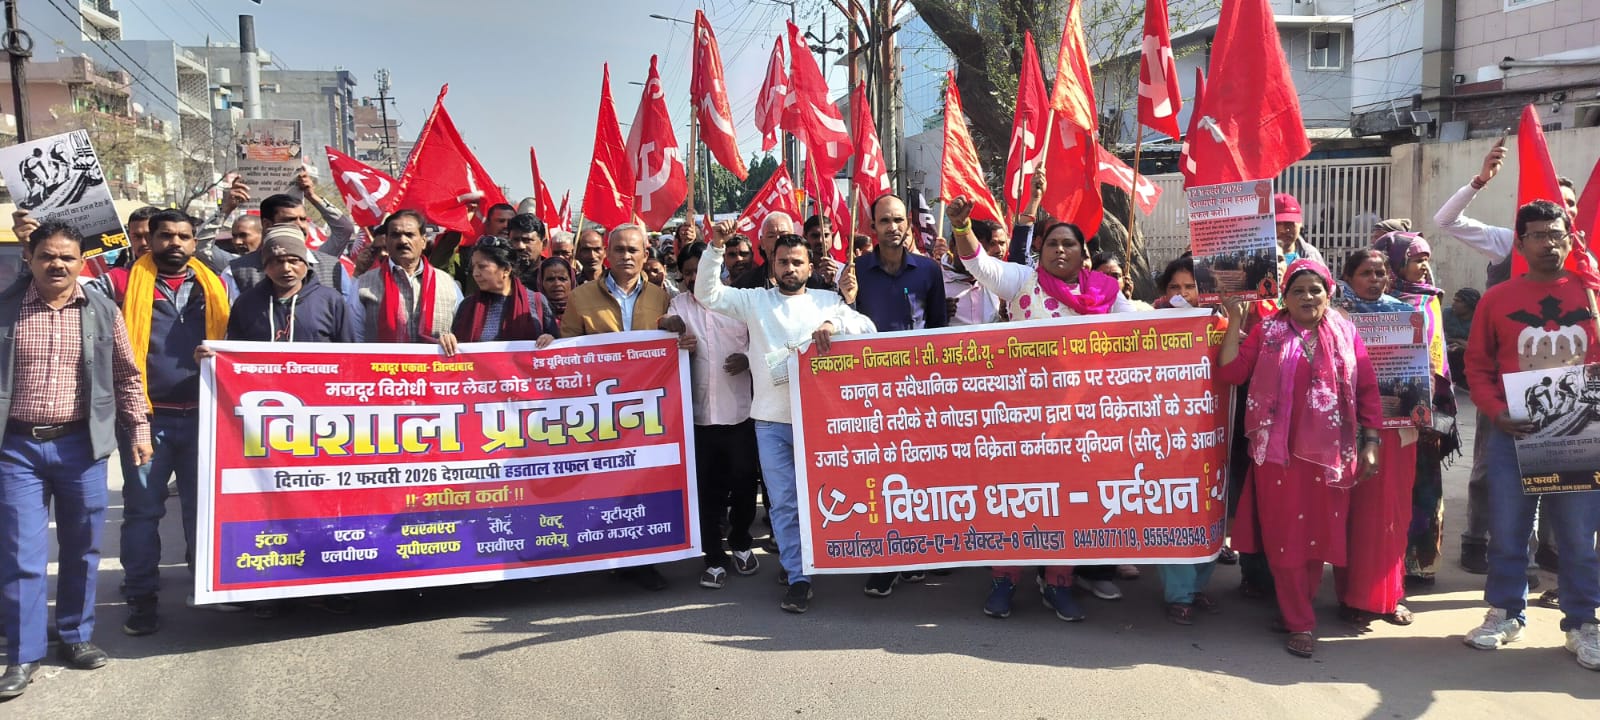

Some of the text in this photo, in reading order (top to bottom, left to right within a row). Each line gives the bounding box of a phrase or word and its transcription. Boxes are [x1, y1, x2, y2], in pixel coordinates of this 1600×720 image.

[1221, 184, 1243, 194] 2026
[101, 232, 129, 247] ऐक्टू
[1069, 338, 1087, 355] पथ
[1089, 329, 1140, 357] विक्रेताओं
[1142, 327, 1157, 351] की
[1160, 331, 1193, 350] एकता
[370, 362, 399, 375] मजदूर
[532, 356, 545, 369] ट्रेड
[583, 352, 595, 363] की
[325, 382, 376, 402] मजदूर
[378, 379, 428, 398] विरोधी
[462, 378, 498, 395] लेबर
[535, 375, 552, 392] रद्द
[556, 372, 584, 389] करो
[840, 355, 1211, 408] कानून व संवैधानिक व्यवस्थाओं को ताक पर रखकर मनमानी
[234, 379, 666, 457] विशाल प्रदर्शन
[826, 409, 883, 435] तानाशाही
[886, 407, 921, 430] तरीके
[924, 410, 937, 429] से
[940, 405, 978, 427] नोएडा
[981, 401, 1042, 428] प्राधिकरण
[1045, 403, 1072, 424] द्वारा
[1075, 402, 1096, 420] पथ
[1099, 394, 1163, 422] विक्रेताओं
[1164, 392, 1180, 415] के
[851, 442, 880, 465] जाने
[883, 441, 897, 462] के
[900, 439, 947, 464] खिलाफ
[951, 443, 971, 459] पथ
[974, 435, 1016, 461] विक्रेता
[1020, 433, 1072, 457] कर्मकार
[1075, 430, 1123, 463] यूनियन
[339, 471, 350, 486] 12
[356, 467, 401, 485] फरवरी
[405, 468, 437, 484] 2026
[441, 462, 501, 481] देशव्यापी
[552, 459, 589, 474] सफल
[592, 450, 636, 470] बनाओं
[1522, 473, 1560, 485] 12 फरवरी
[422, 488, 470, 507] अपील
[475, 485, 509, 503] कर्ता
[865, 477, 879, 524] CITU
[881, 473, 978, 524] विशाल
[983, 482, 1060, 519] धरना
[1069, 491, 1089, 503] -
[255, 504, 646, 548] इंटक एटक एचएमएस सीटू ऐक्टू यूटीयूसी
[826, 531, 884, 558] कार्यालय
[1023, 525, 1065, 550] नोएडा
[1073, 527, 1140, 551] 8447877119,
[1143, 526, 1210, 551] 9555429548,
[236, 550, 306, 571] टीयूसीआई
[321, 546, 379, 563] एलपीएफ
[396, 540, 461, 560] यूपीएलएफ
[577, 528, 604, 543] लोक
[608, 525, 644, 542] मजदूर
[647, 522, 672, 536] सभा
